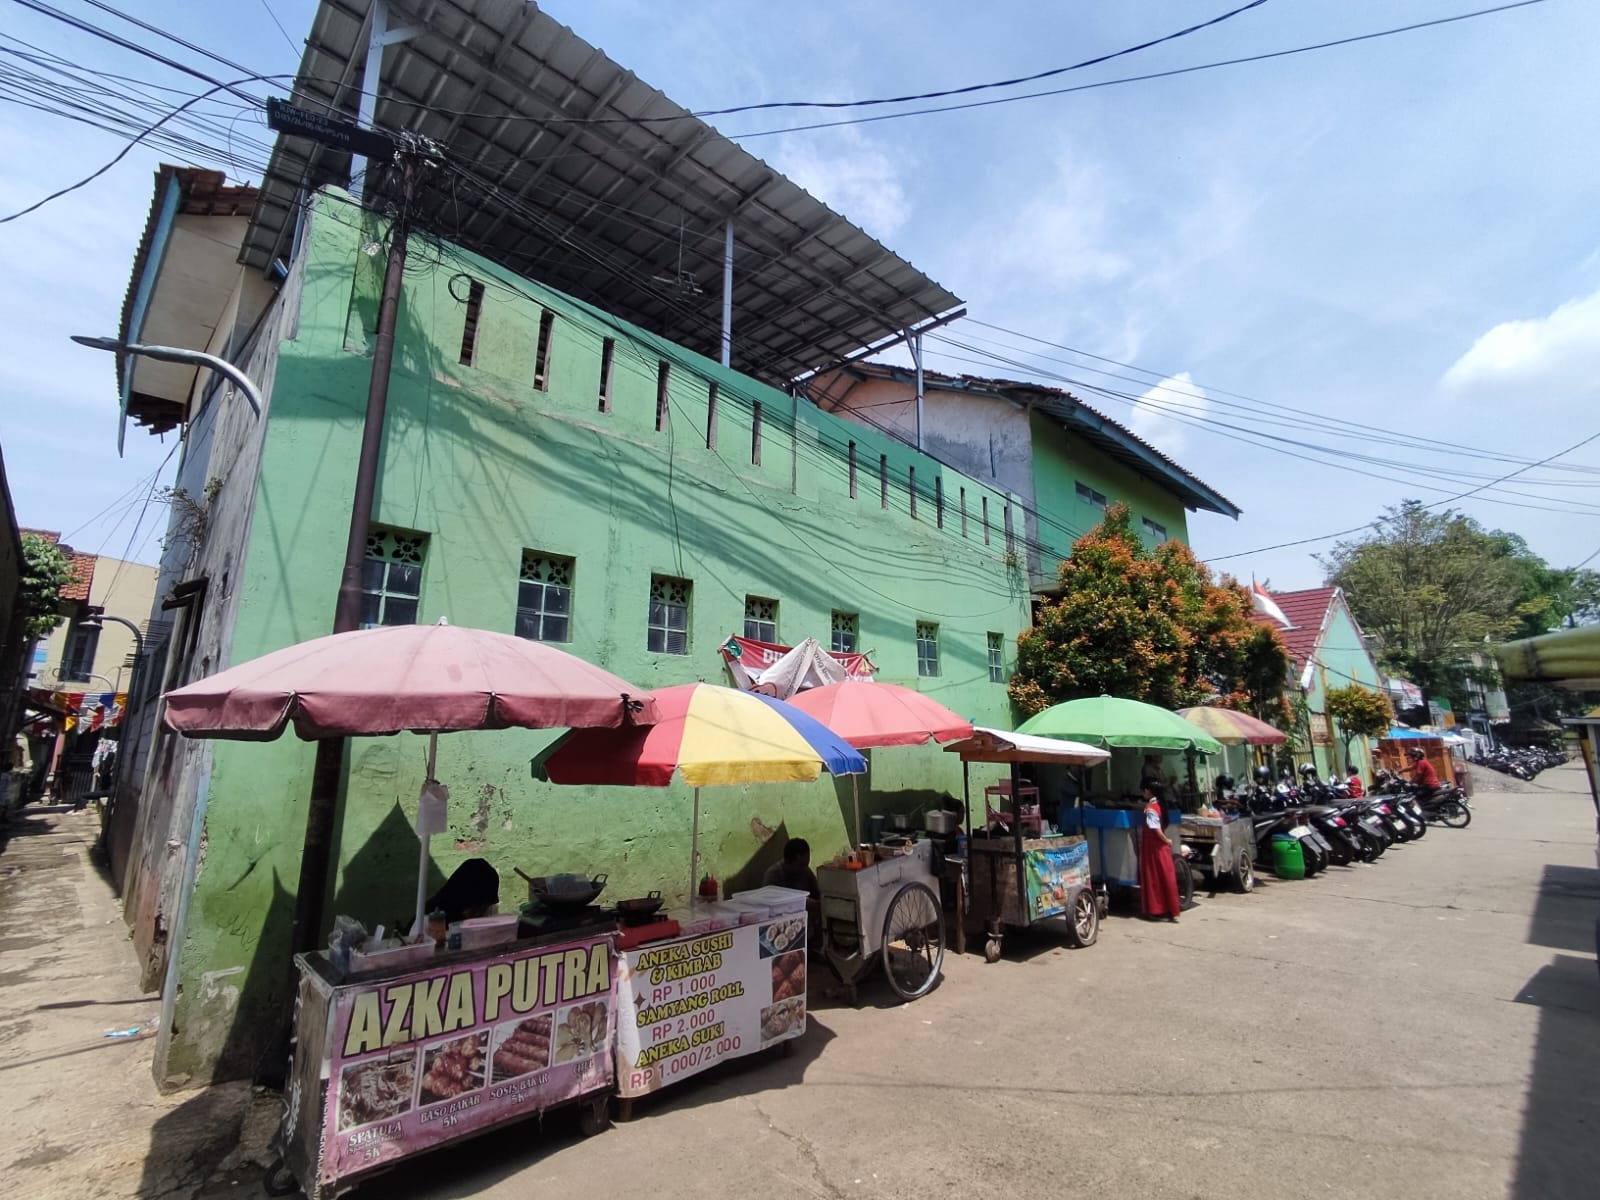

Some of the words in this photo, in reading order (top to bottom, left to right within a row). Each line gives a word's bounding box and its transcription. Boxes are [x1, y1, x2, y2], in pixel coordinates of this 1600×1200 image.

[636, 945, 690, 970] ANEKA
[692, 933, 734, 957] SUSHI
[650, 966, 665, 985] &
[666, 953, 722, 982] KIMBAB
[342, 970, 476, 1059] AZKA
[484, 943, 611, 1022] PUTRA
[636, 992, 708, 1027] SAMYANG
[709, 982, 744, 1004] ROLL
[652, 985, 672, 1004] RP
[678, 974, 716, 998] 1.000
[652, 1022, 672, 1042] RP
[678, 1009, 715, 1033] 2.000
[635, 1040, 690, 1068] ANEKA
[691, 1022, 725, 1047] SUKI
[630, 1069, 654, 1089] RP
[659, 1036, 741, 1080] 1.000/2.000
[489, 1086, 518, 1101] SOSIS
[520, 1073, 549, 1090] BAKAR
[420, 1107, 447, 1124] BASO
[448, 1095, 481, 1114] BAKAR
[443, 1115, 458, 1128] 5K
[349, 1120, 402, 1146] SPATULA
[365, 1148, 380, 1161] 5K
